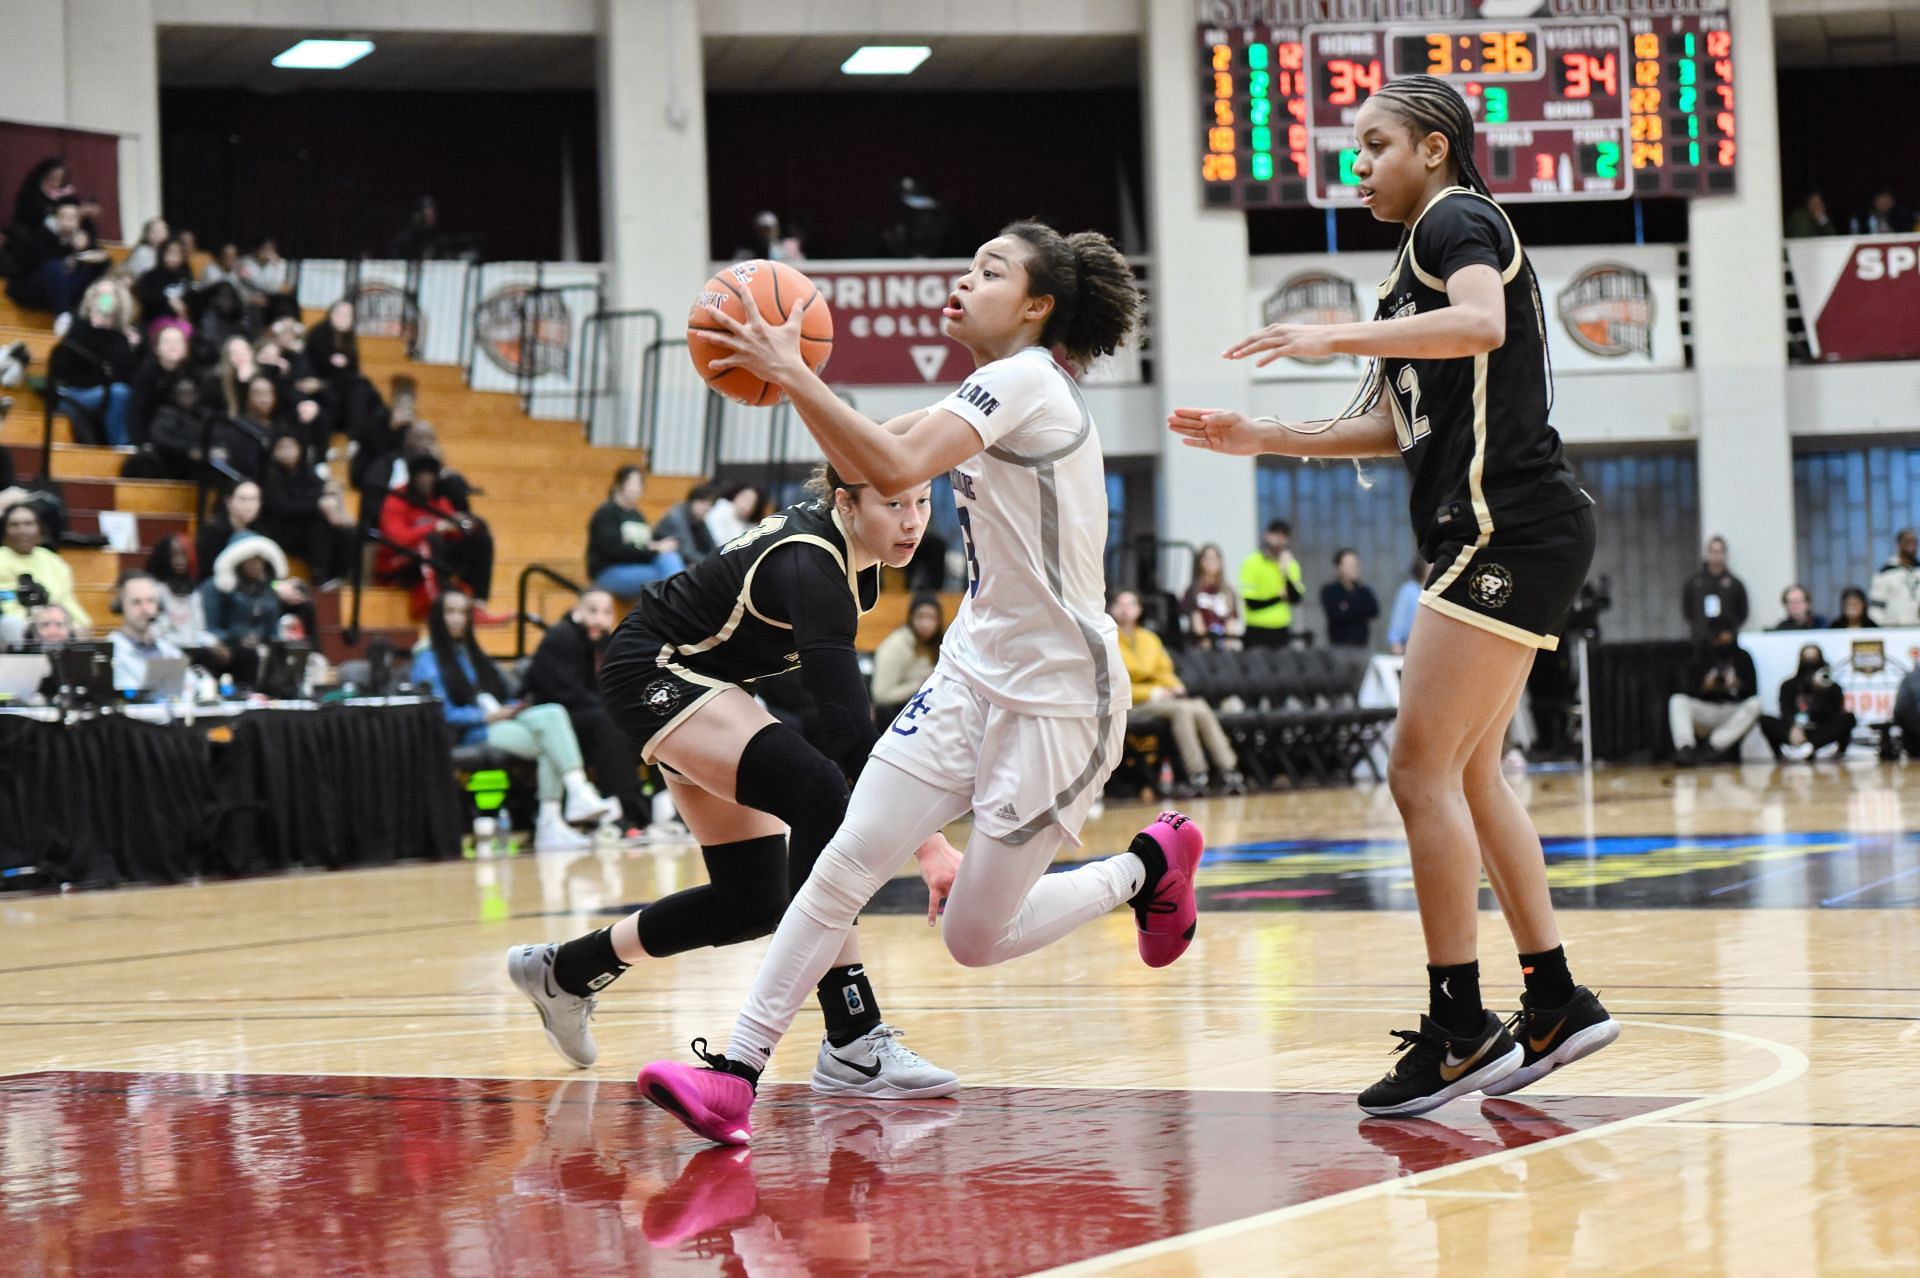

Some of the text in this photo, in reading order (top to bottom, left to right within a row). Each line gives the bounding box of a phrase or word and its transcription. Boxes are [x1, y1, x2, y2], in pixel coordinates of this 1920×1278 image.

[1425, 32, 1533, 75] 3:36
[1327, 59, 1382, 105] 34
[1562, 53, 1617, 98] 34
[1483, 86, 1509, 123] 3
[1596, 140, 1620, 179] 2
[1855, 245, 1920, 281] SP
[1385, 363, 1432, 452] 12
